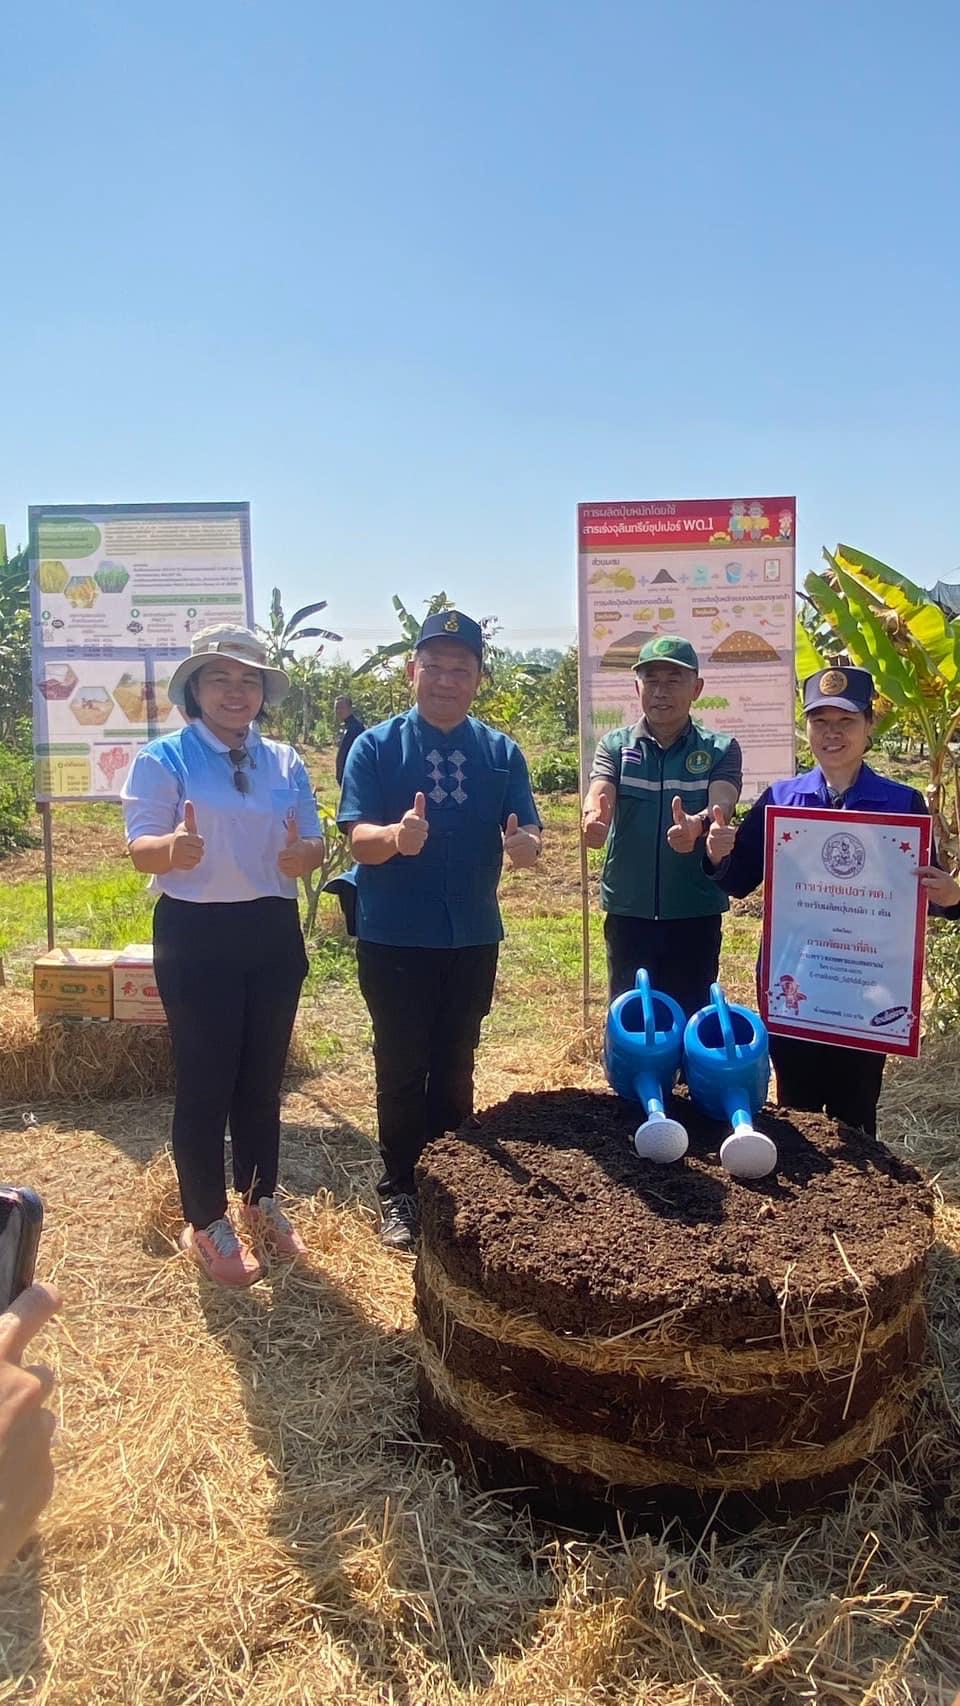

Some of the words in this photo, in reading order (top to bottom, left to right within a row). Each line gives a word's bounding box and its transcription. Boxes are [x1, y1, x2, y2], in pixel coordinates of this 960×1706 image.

[583, 504, 676, 519] การผลิตปุ๋ยหมักโดยใช้
[583, 520, 682, 537] สารเร่งจุลินทรีย์ซุปเปอร์
